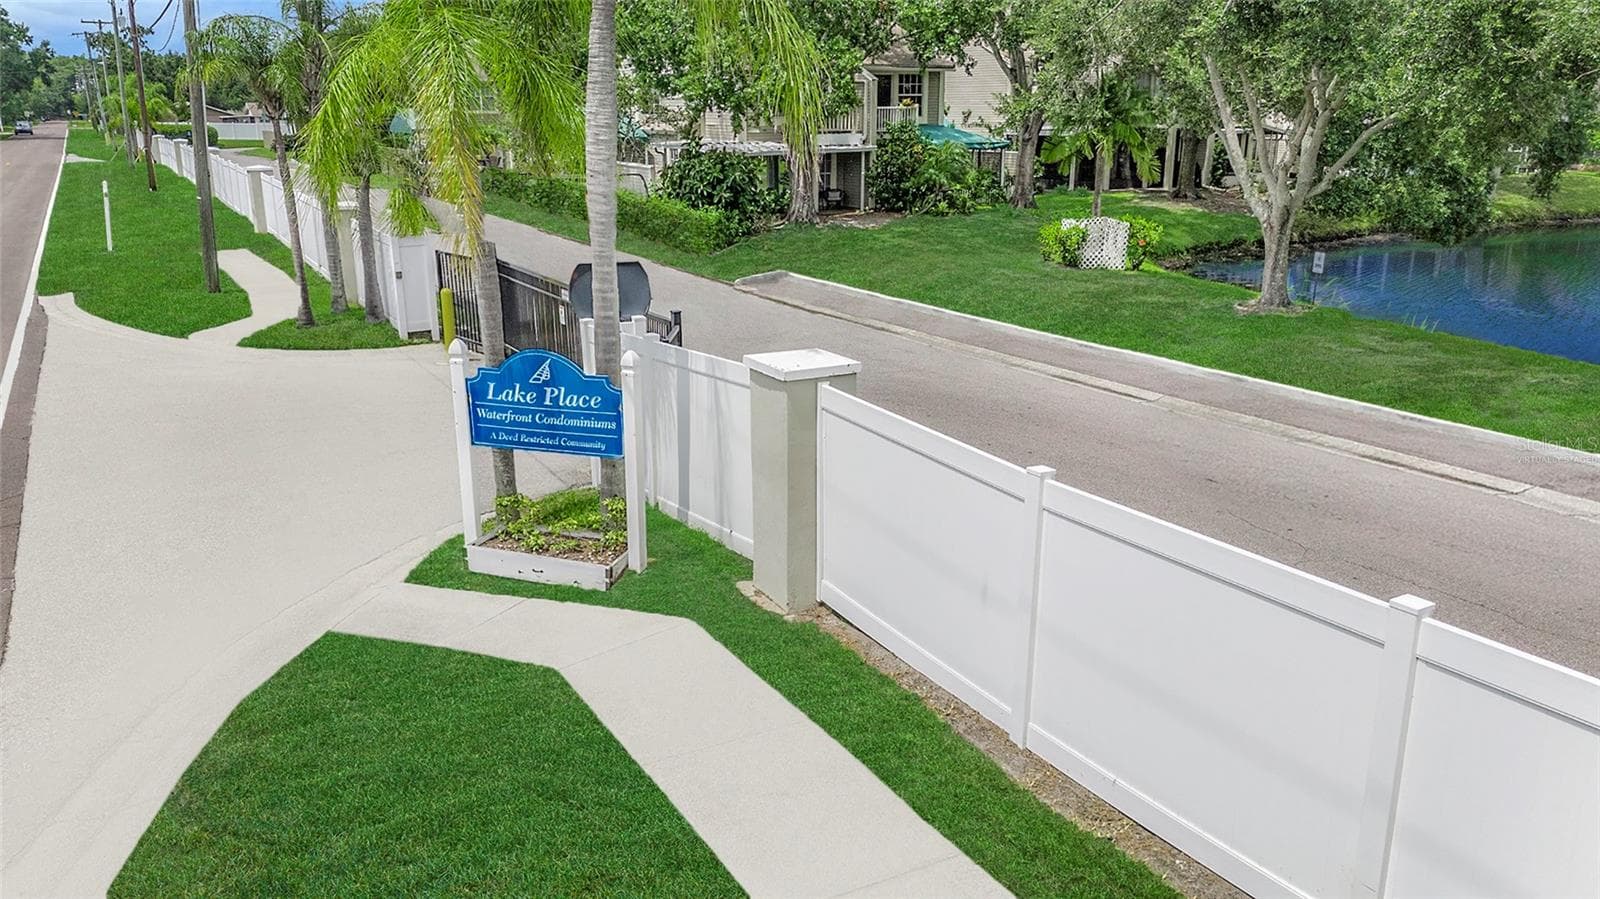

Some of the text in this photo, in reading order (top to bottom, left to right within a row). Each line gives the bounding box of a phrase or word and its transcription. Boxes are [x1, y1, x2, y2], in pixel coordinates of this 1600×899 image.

[486, 382, 602, 408] Lake Place
[476, 407, 617, 430] Waterfront Condominiums
[490, 432, 606, 450] A Deed Restricted Community
